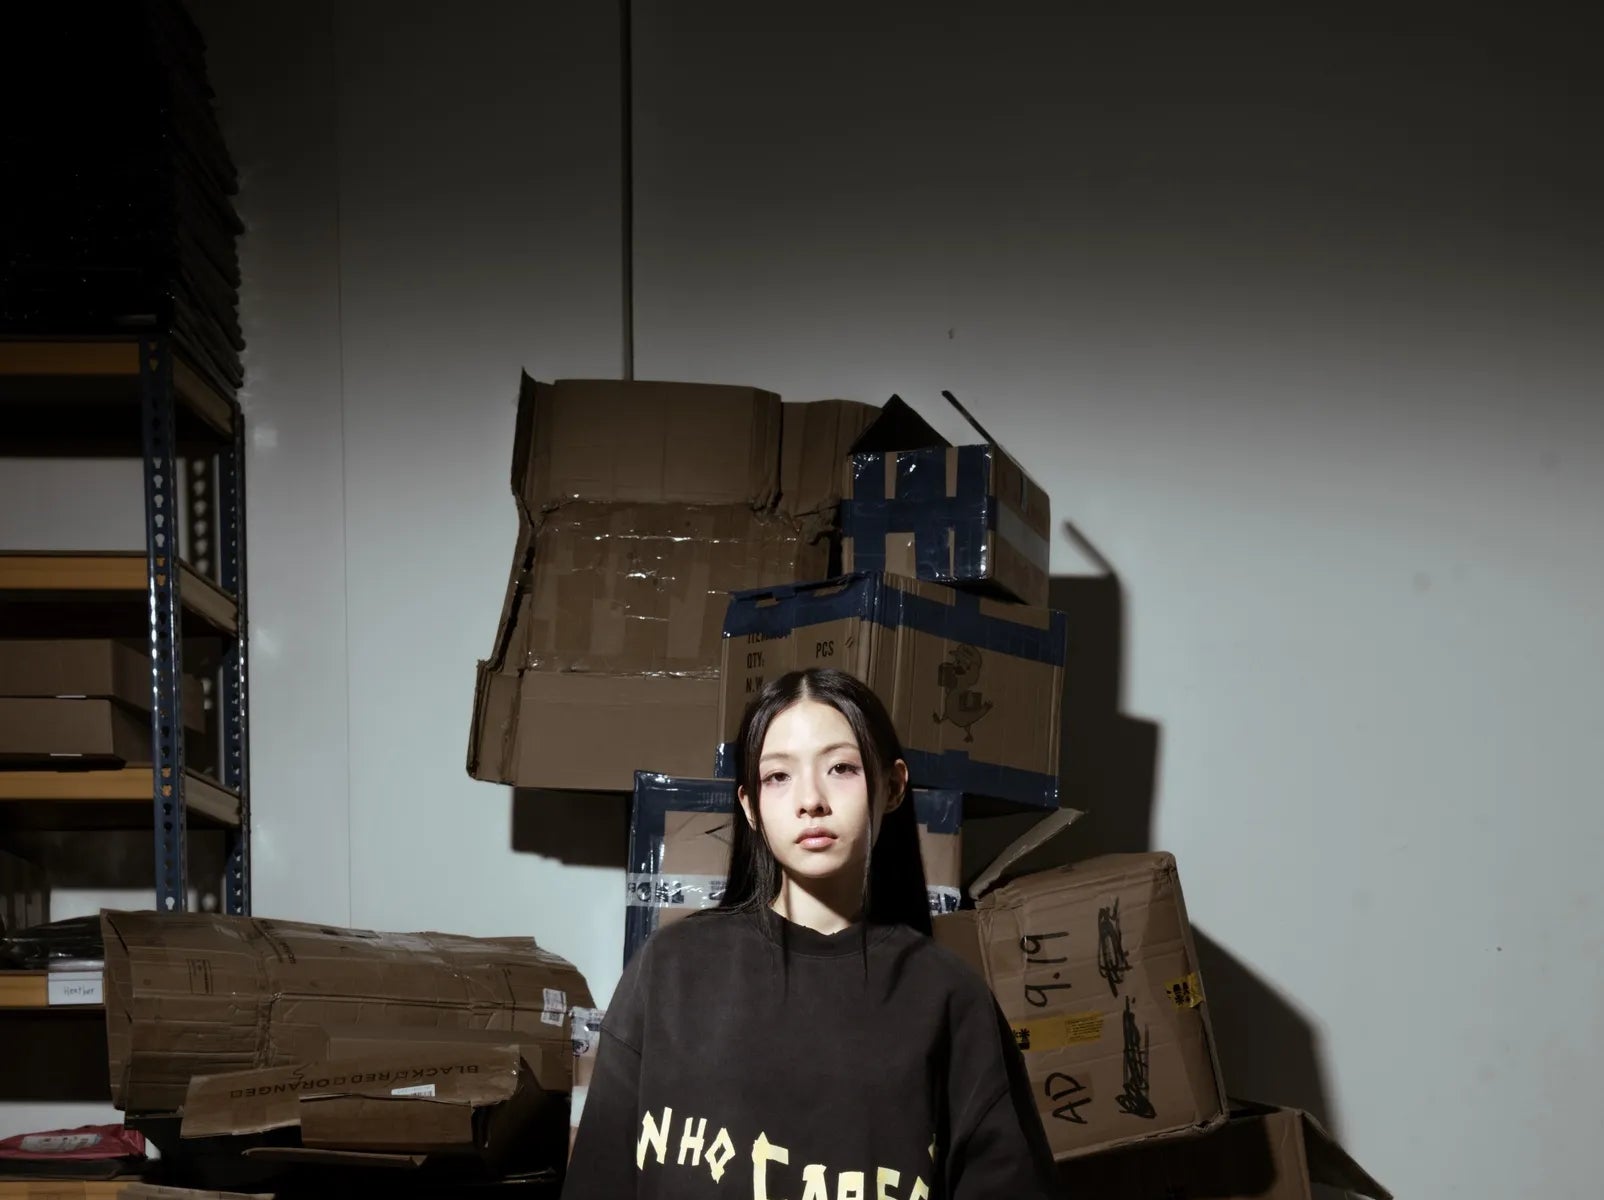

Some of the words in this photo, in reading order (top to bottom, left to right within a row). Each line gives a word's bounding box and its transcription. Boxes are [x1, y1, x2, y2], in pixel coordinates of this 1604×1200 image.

[815, 641, 835, 658] PCS
[1020, 931, 1071, 1007] 9.19
[351, 1072, 390, 1083] RED
[413, 1065, 479, 1078] BLACK
[245, 1078, 329, 1097] ORANGE
[1044, 1072, 1092, 1124] AD
